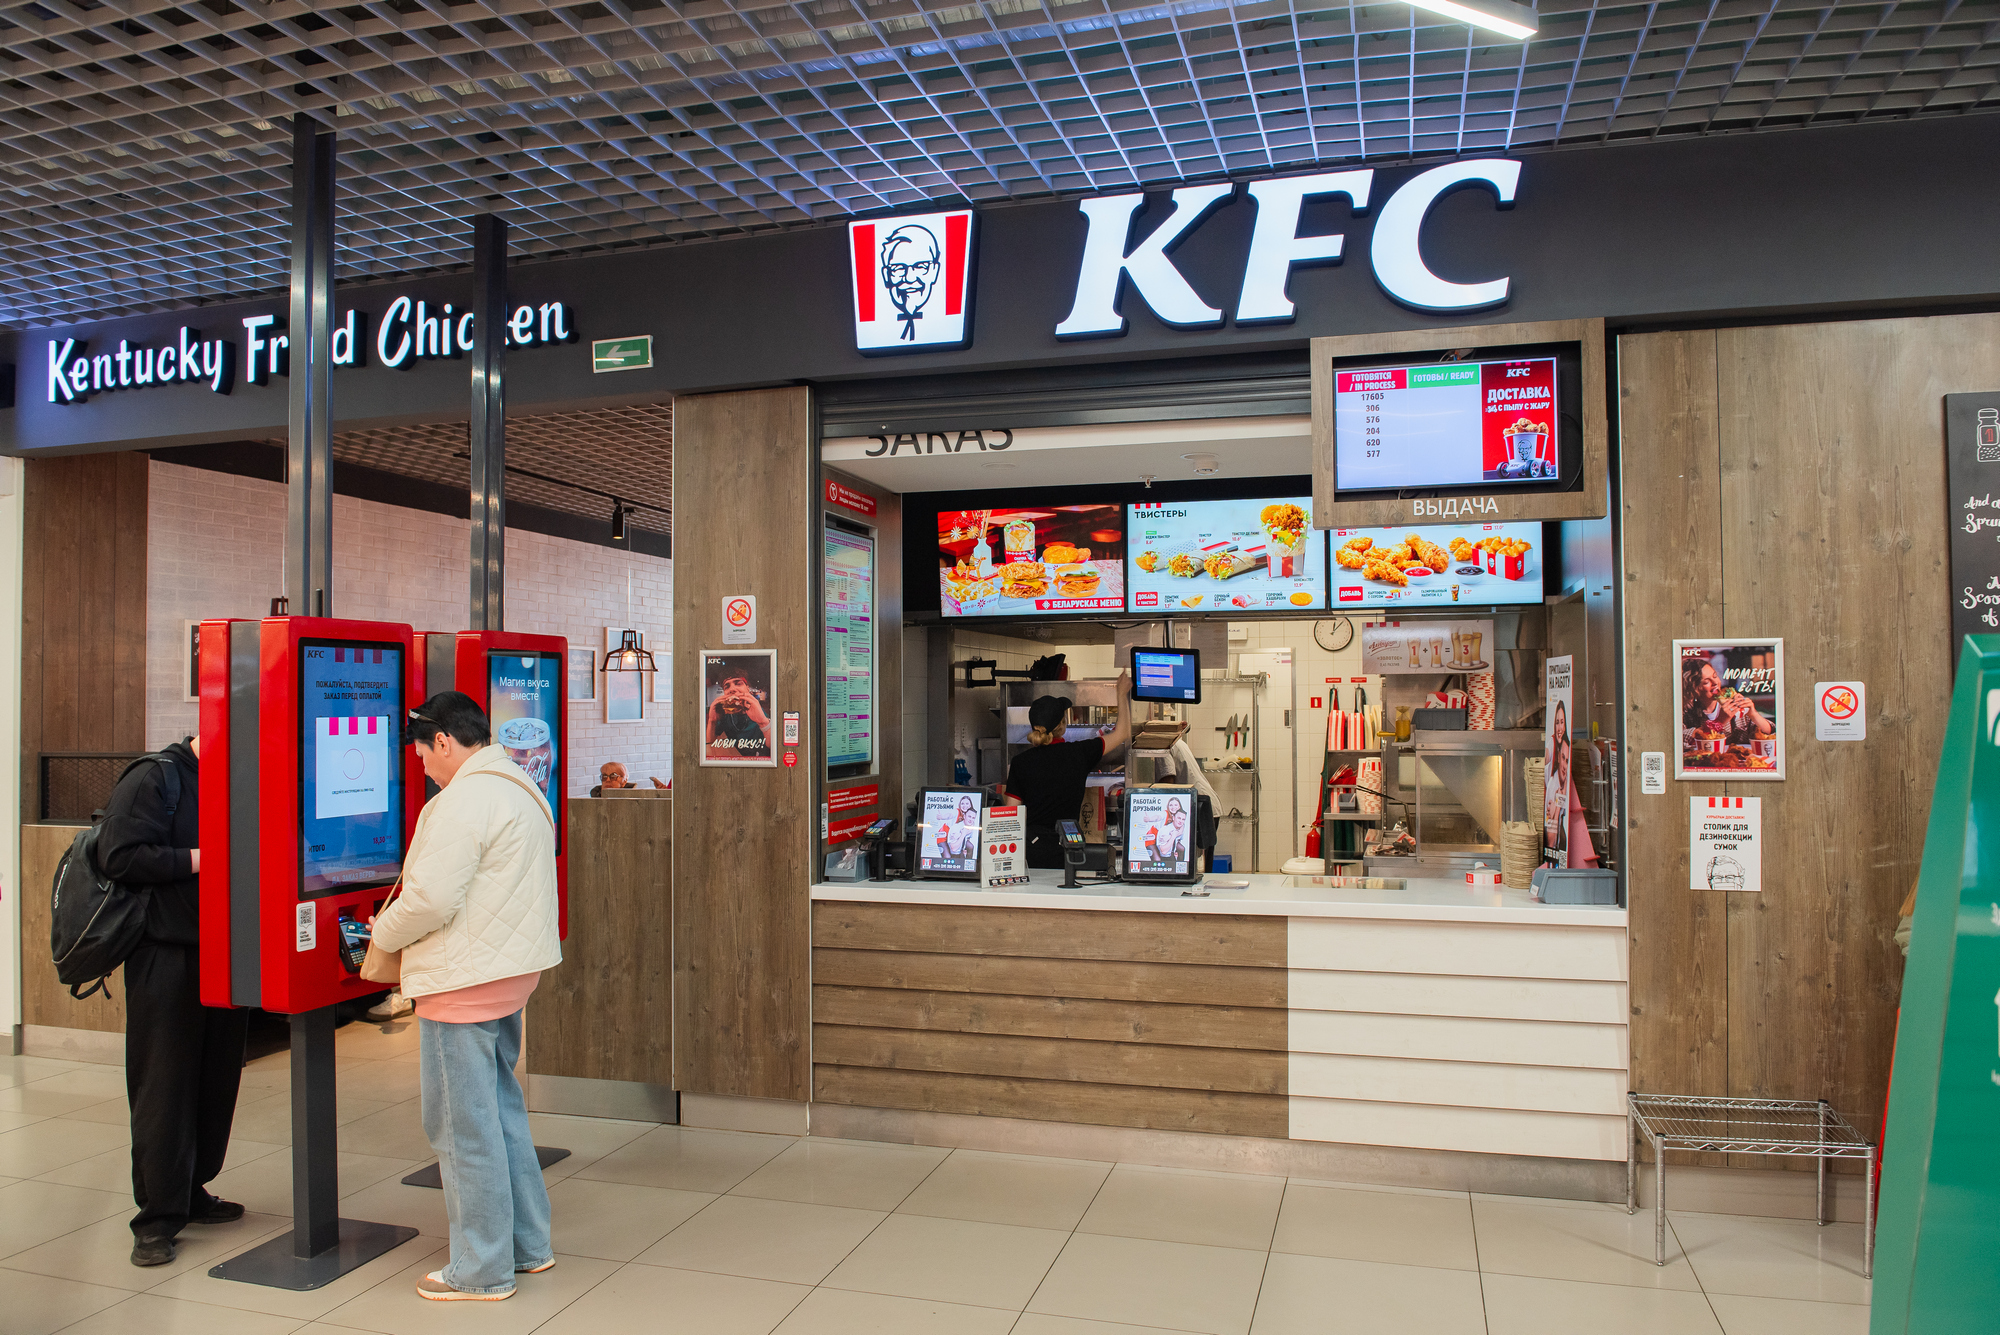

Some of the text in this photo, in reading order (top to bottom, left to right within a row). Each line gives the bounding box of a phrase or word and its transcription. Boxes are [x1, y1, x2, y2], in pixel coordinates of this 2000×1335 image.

[1055, 158, 1522, 334] KFC
[48, 295, 569, 402] Kentucky Frd Chicen
[1351, 371, 1392, 382] ГОТОВЯТСЯ
[1413, 372, 1444, 383] ГОТОВЫ
[1450, 370, 1475, 381] READY
[1506, 367, 1531, 378] KFC
[1354, 382, 1363, 391] IN
[1364, 380, 1396, 391] PROCESS
[1361, 392, 1385, 401] 17605
[1487, 386, 1551, 403] ДОСТАВКА
[1365, 404, 1380, 412] 306
[1498, 401, 1550, 412] С ПЫЛУ С ЖАРУ
[1366, 415, 1380, 424] 576
[1366, 427, 1380, 435] 204
[1984, 428, 1994, 442] 1
[1366, 438, 1380, 447] 620
[1366, 450, 1380, 458] 577
[1963, 493, 1990, 510] And
[1413, 497, 1499, 519] ВЫДАЧА
[1135, 509, 1187, 519] ТВИСТЕРЫ
[1052, 598, 1122, 608] БЕЛАРУСКАЕ МЕНЮ
[1981, 607, 1999, 627] of
[307, 649, 325, 659] KFC
[1463, 644, 1469, 655] 3
[1722, 667, 1775, 680] МОМЕНТ
[315, 679, 389, 690] ПОЖАЛУЙСТА, ПОДТВЕРДИТЕ
[499, 676, 550, 690] Магия вкуса
[1555, 675, 1571, 688] РАБОТУ
[1737, 680, 1775, 693] ЕСТЬ!
[323, 691, 382, 701] ЗАКАЗ ПЕРЕД ОПЛАТОЙ
[510, 691, 539, 701] вместе
[710, 737, 766, 749] ЛОВИ ВКУС!
[927, 795, 950, 803] РАБОТАЙ
[1132, 797, 1157, 805] РАБОТАЙ
[1703, 822, 1749, 832] СТОЛИК ДЛЯ
[1699, 832, 1753, 842] ДЕЗИНФЕКЦИИ
[308, 843, 326, 853] ИТОГО
[342, 873, 359, 882] ЗАКАЗ
